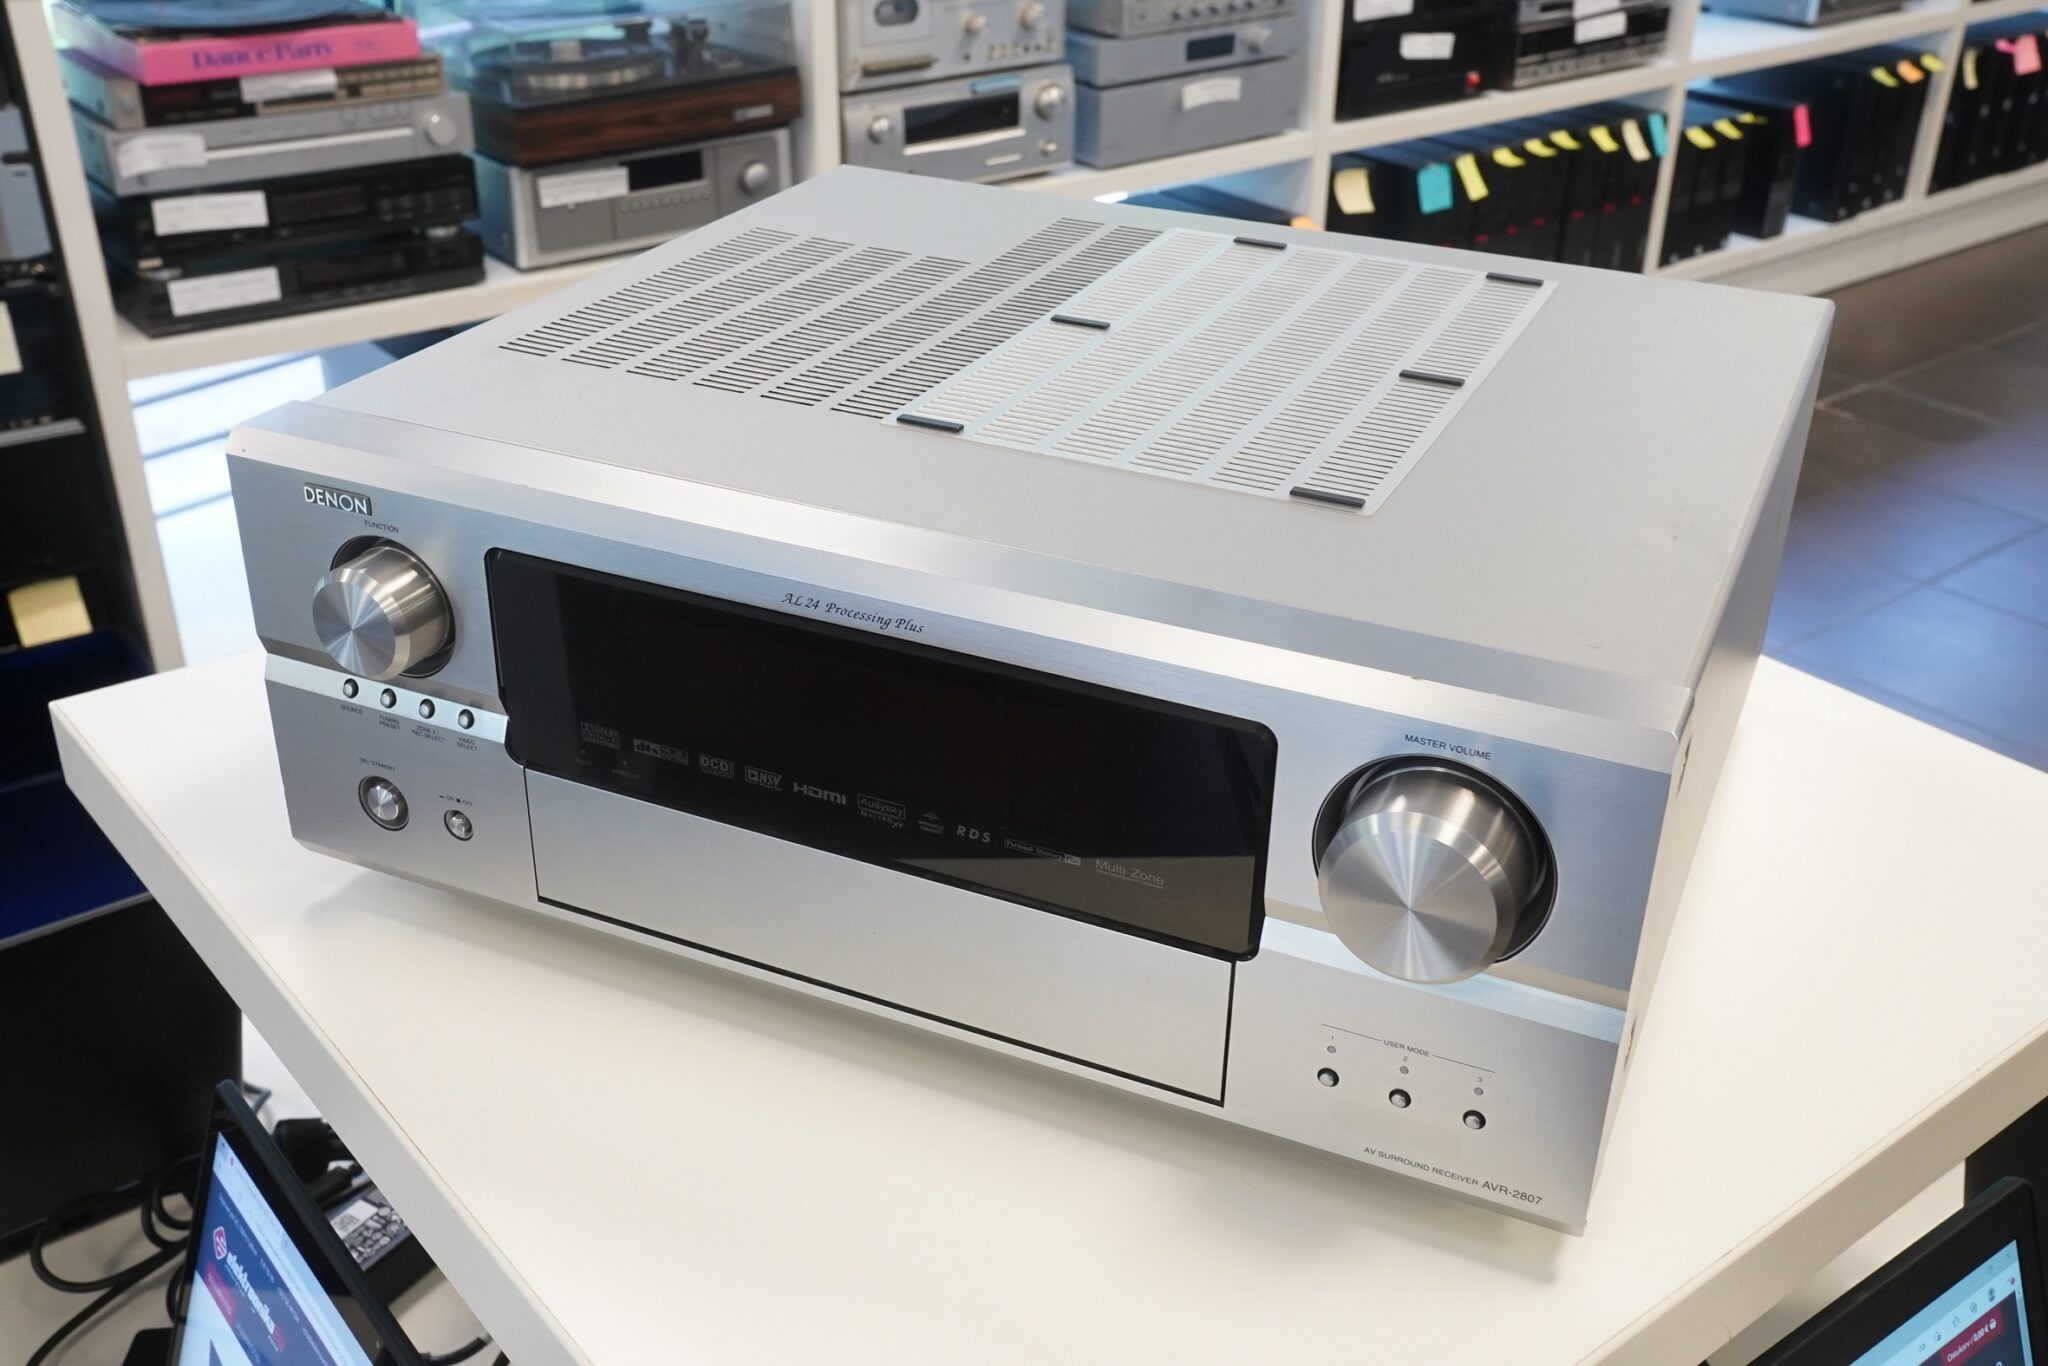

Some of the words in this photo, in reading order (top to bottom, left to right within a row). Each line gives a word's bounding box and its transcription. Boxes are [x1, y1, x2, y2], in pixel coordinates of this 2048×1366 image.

[303, 486, 367, 515] DENON
[364, 519, 400, 534] FUNCTION
[782, 592, 803, 607] AL
[804, 597, 821, 611] 24
[825, 602, 893, 630] Processing
[895, 618, 925, 633] Plus
[1405, 734, 1446, 750] MASTER
[1449, 744, 1492, 760] VOLUME
[861, 798, 903, 817] Audyssey
[1096, 858, 1126, 876] Multi
[1130, 868, 1165, 886] Zone
[1383, 1039, 1405, 1051] USER
[1406, 1045, 1430, 1057] MODE
[1363, 1146, 1376, 1155] AV
[1378, 1150, 1430, 1172] SURROUND
[1432, 1166, 1479, 1186] RECEIVER
[1482, 1181, 1543, 1205] AVR-2807
